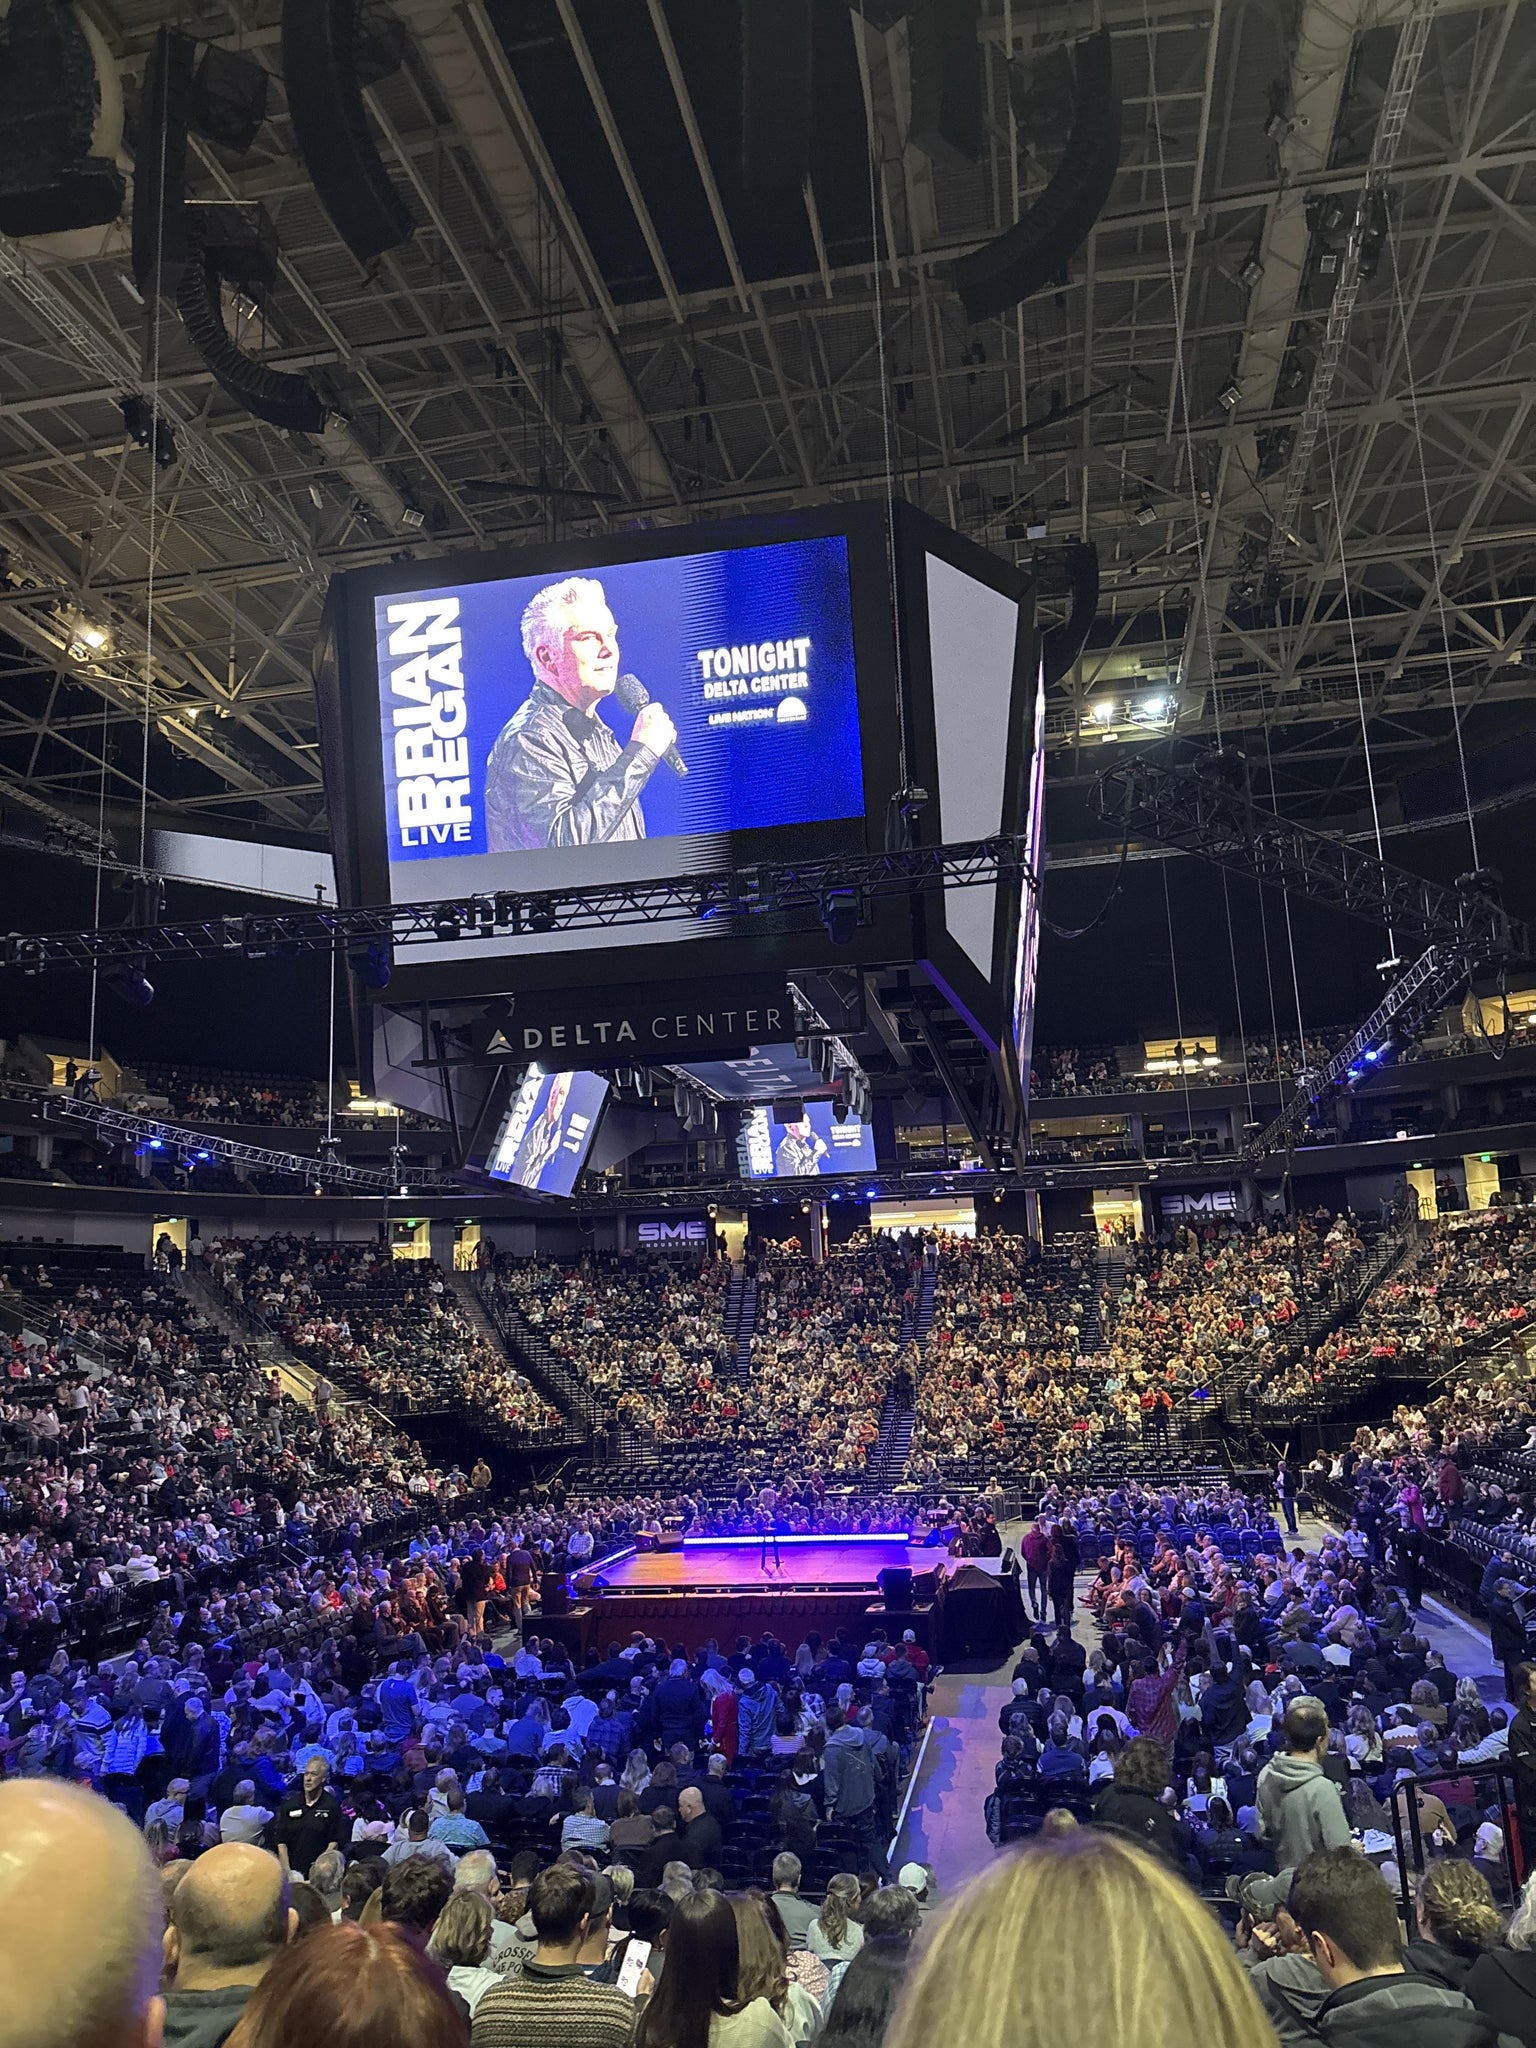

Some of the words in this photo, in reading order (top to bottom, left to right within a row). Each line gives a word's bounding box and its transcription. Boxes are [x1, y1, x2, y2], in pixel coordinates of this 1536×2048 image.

[697, 637, 810, 678] TONIGHT
[703, 679, 749, 699] DELTA
[751, 672, 808, 693] CENTER
[387, 600, 436, 828] BRIAN
[426, 597, 472, 825] REGAN
[401, 822, 472, 847] LIVE
[523, 1020, 637, 1050] DELTA
[651, 1008, 782, 1039] CENTER
[494, 1160, 512, 1174] LIVE
[1161, 1191, 1238, 1214] SME
[639, 1221, 706, 1241] SME
